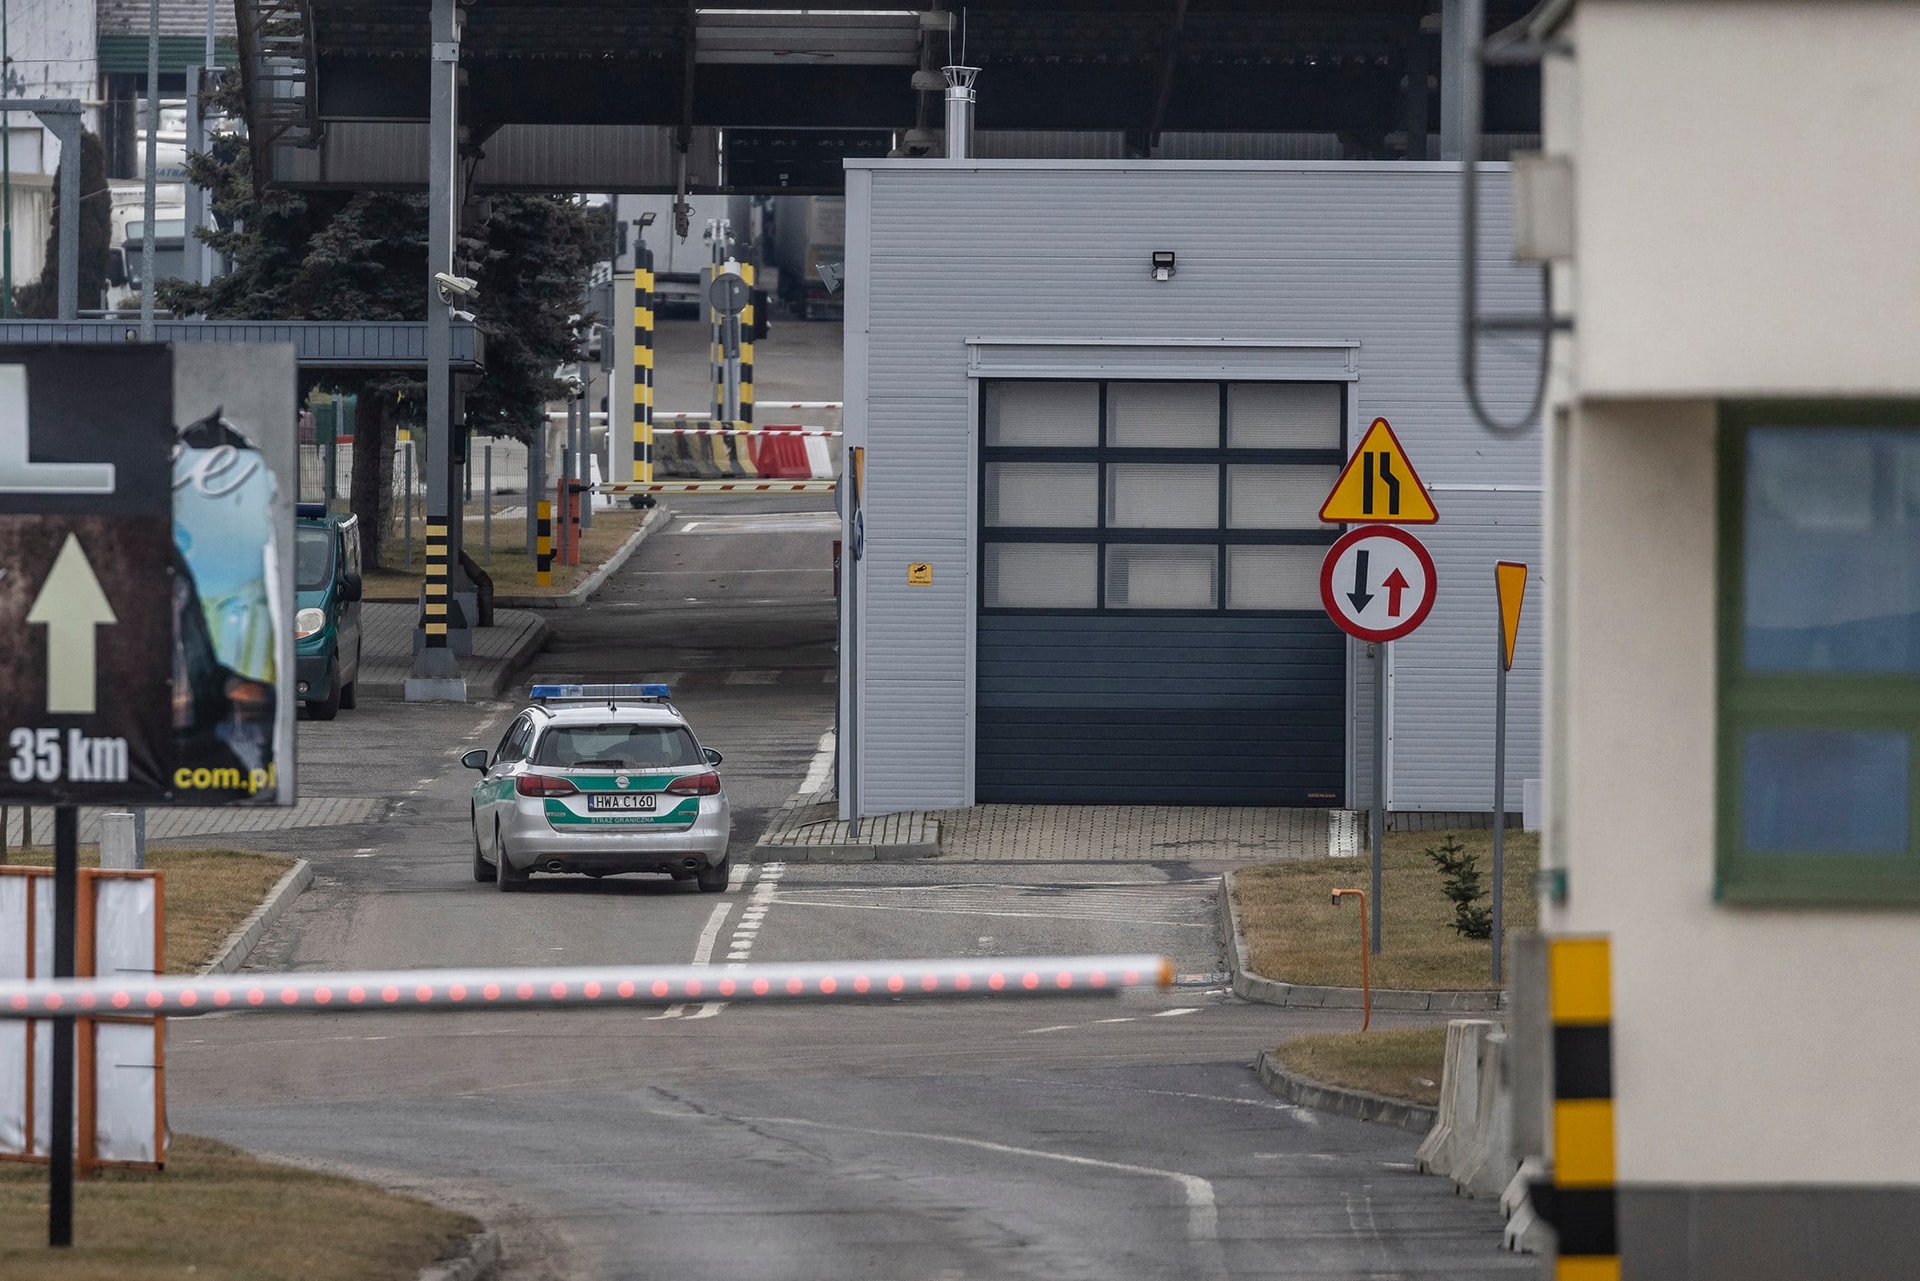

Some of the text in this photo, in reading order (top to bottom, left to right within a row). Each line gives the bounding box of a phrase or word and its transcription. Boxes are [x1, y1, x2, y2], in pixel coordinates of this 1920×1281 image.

[9, 727, 129, 783] 35 km
[596, 796, 653, 807] HWA C160
